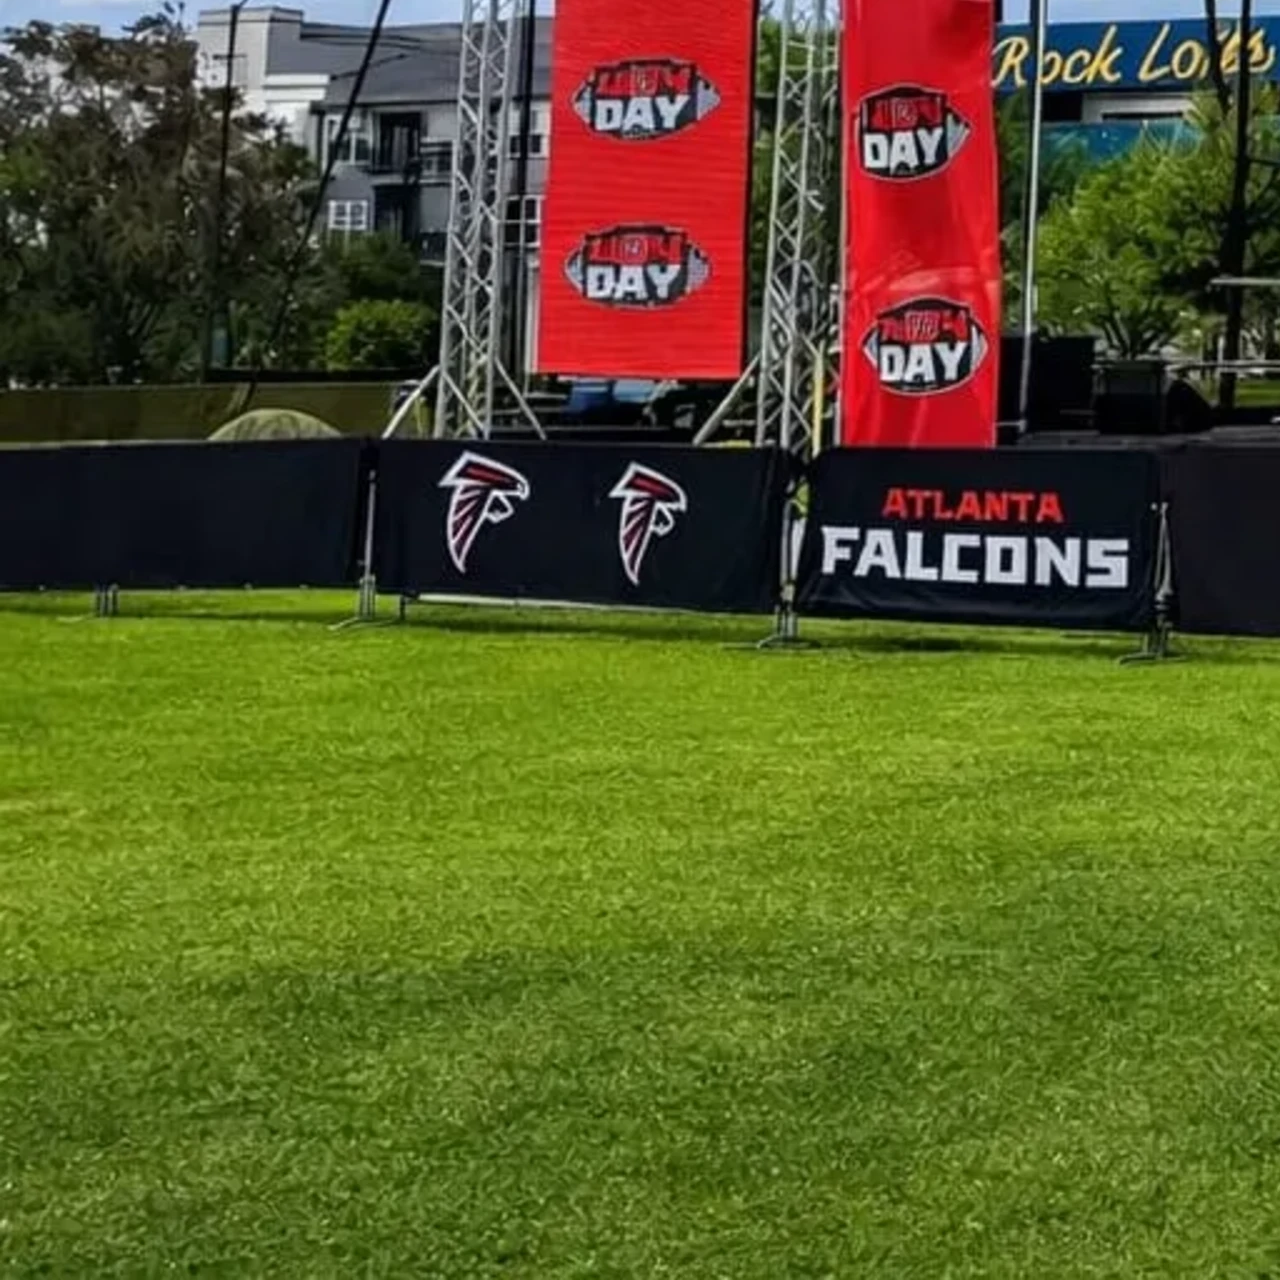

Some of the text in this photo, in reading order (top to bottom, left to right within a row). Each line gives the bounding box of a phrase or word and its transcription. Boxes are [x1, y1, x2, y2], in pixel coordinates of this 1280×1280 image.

[990, 24, 1123, 88] Rock
[595, 94, 690, 131] DAY
[864, 126, 943, 176] DAY
[587, 264, 681, 299] DAY
[880, 340, 968, 382] DAY
[882, 487, 1064, 523] ATLANTA
[821, 525, 1129, 588] FALCONS
